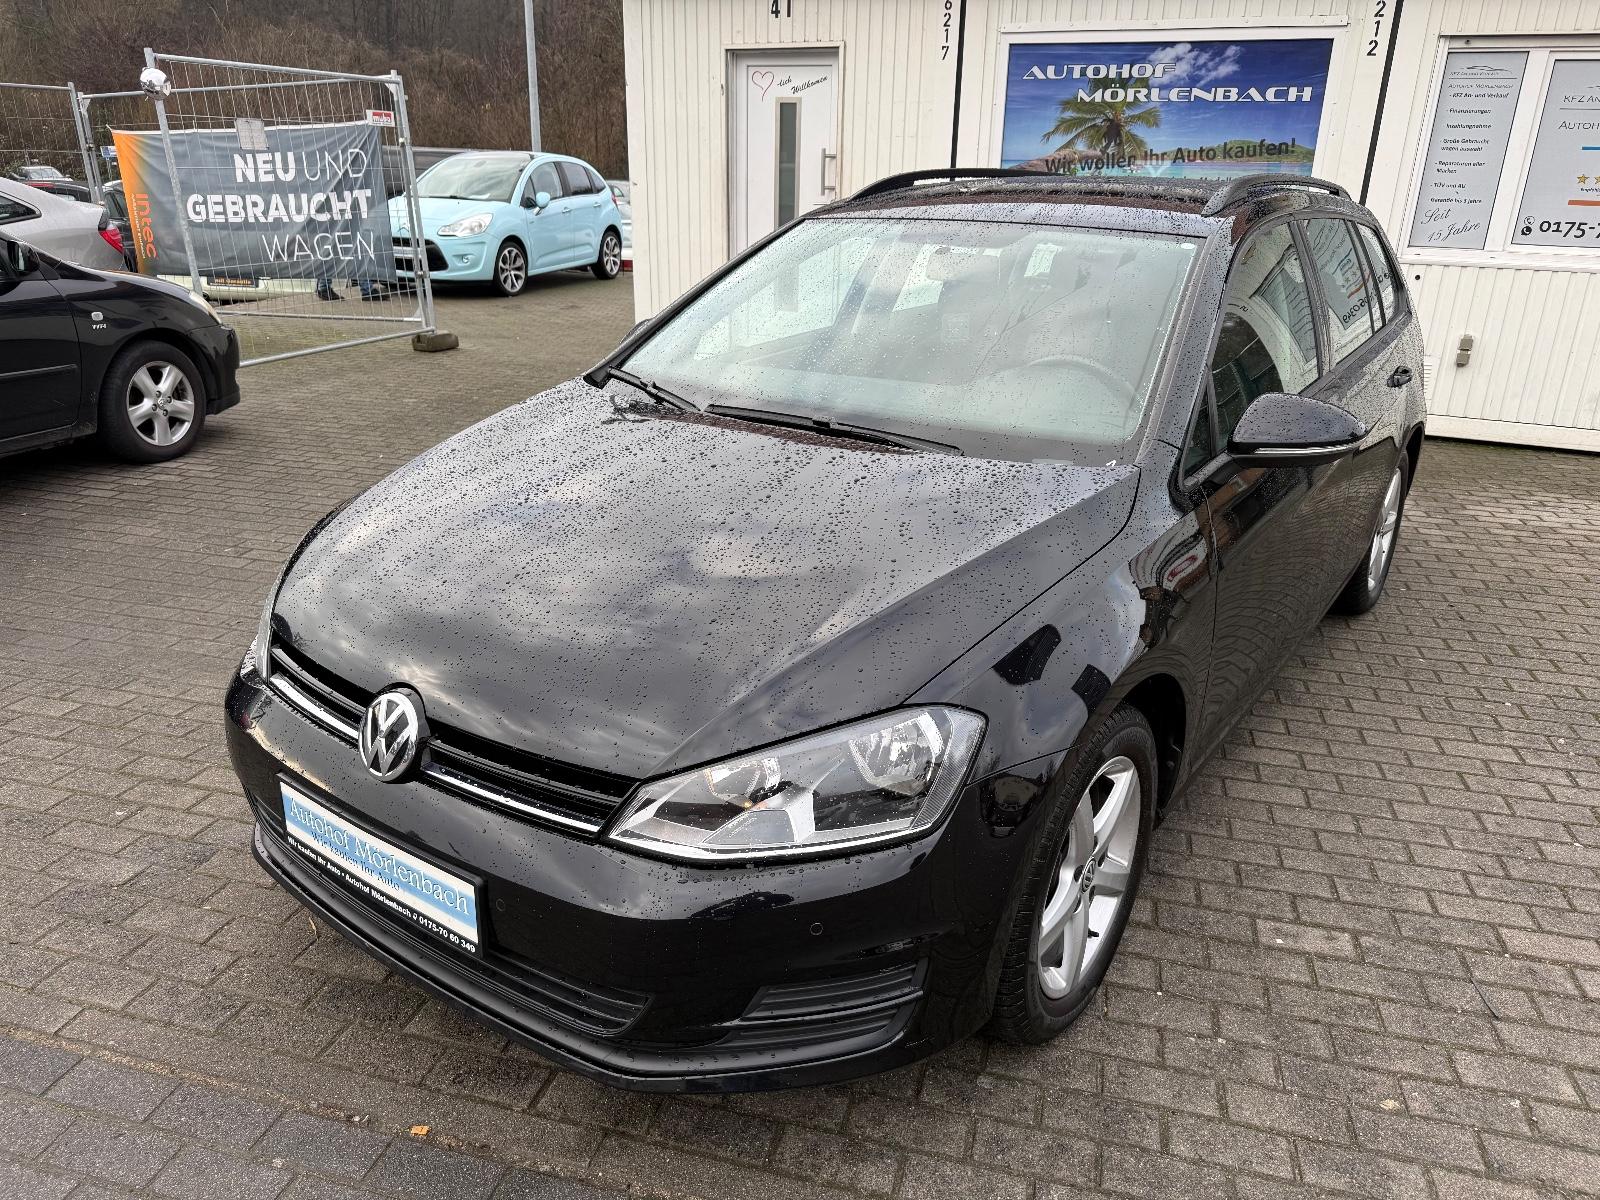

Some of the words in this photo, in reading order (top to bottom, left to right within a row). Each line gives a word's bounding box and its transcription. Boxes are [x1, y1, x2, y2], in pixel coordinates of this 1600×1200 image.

[1022, 62, 1176, 80] AUTOHOF
[1077, 83, 1312, 103] MÖRLENBACH
[1563, 95, 1585, 103] KFZ
[233, 152, 296, 183] NEU
[302, 148, 367, 181] UND
[1080, 151, 1137, 171] wollen
[1143, 148, 1169, 164] Ihr
[1172, 146, 1217, 164] Auto
[1222, 137, 1296, 160] kaufen!
[186, 189, 371, 223] GEBRAUCHT
[262, 231, 375, 262] WAGEN
[290, 797, 350, 850] Autohof
[355, 836, 470, 916] Mörlenbach
[287, 836, 297, 847] Wir
[327, 862, 341, 876] Auto
[345, 874, 369, 893] Autohof
[371, 888, 412, 918] Mörlenbach
[460, 939, 476, 953] 349
